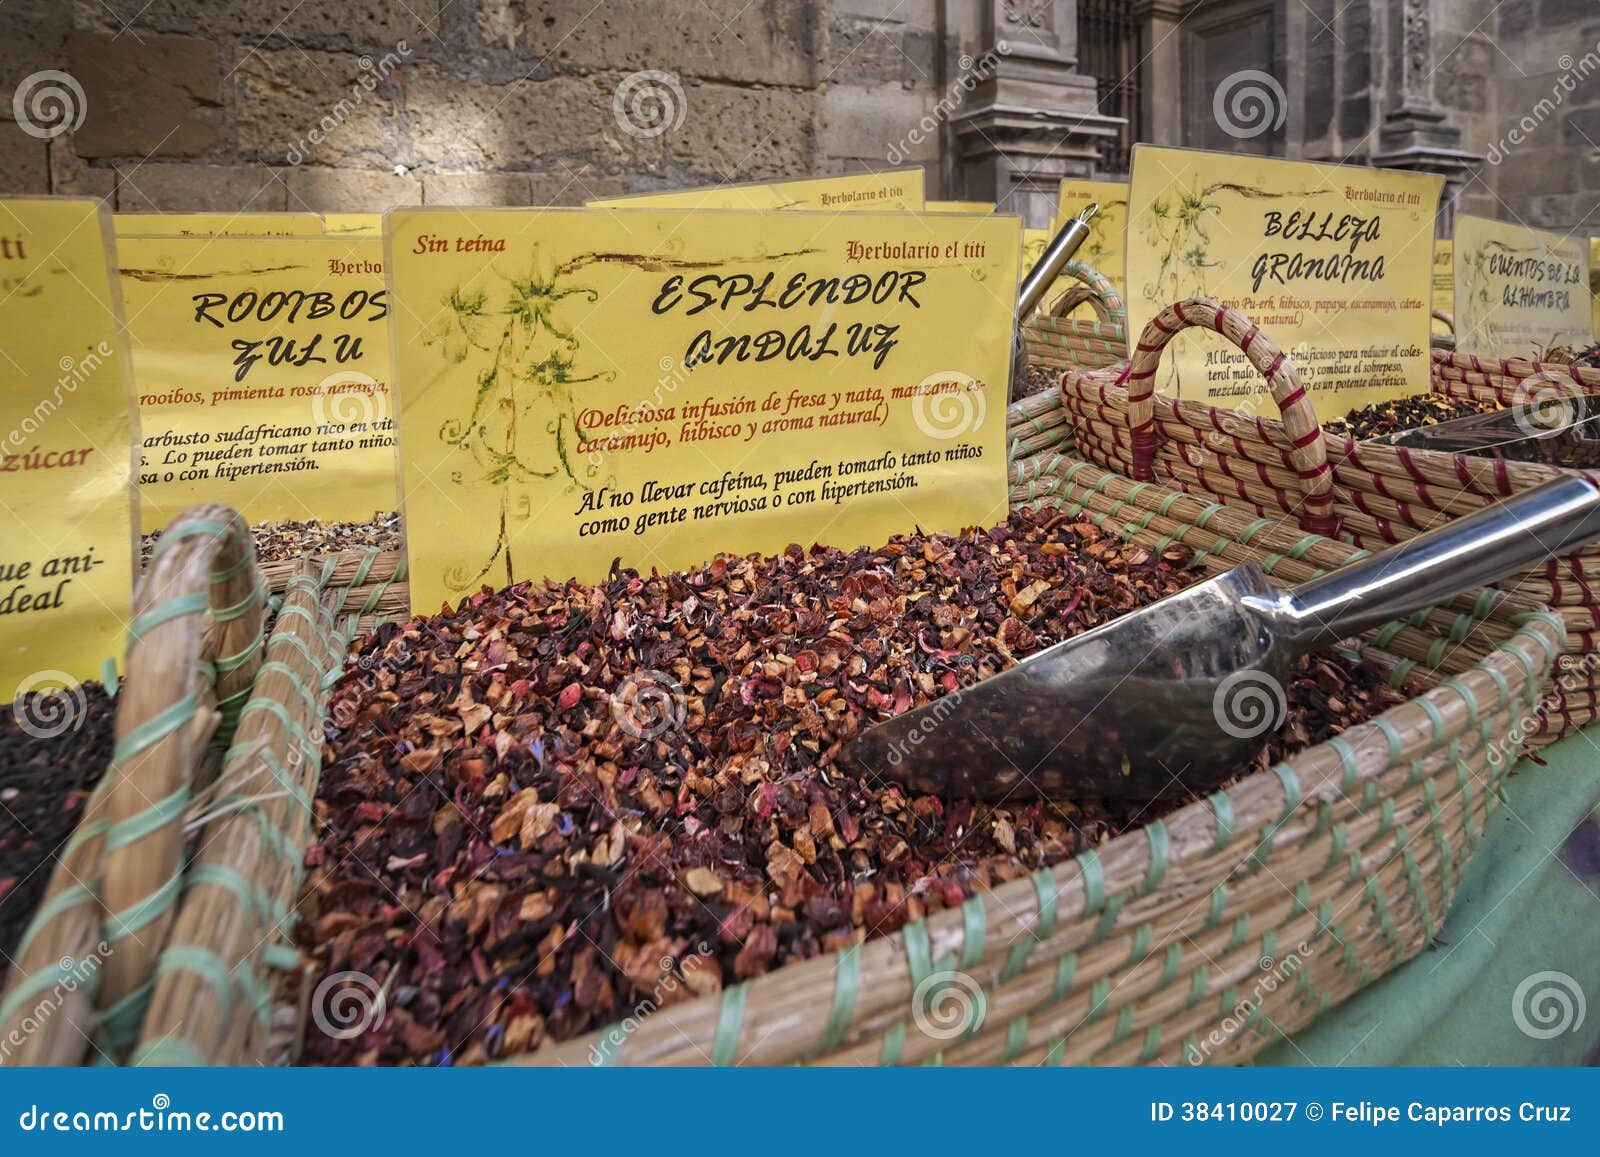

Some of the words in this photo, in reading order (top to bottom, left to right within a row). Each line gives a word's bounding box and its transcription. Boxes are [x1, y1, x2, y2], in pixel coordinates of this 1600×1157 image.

[878, 187, 887, 198] el
[1397, 192, 1405, 204] el
[413, 234, 448, 254] Sin
[455, 234, 505, 252] teína
[1264, 210, 1380, 254] BELLEZA
[846, 241, 939, 262] Herbolario
[945, 241, 958, 258] el
[963, 241, 986, 258] titi
[1489, 253, 1546, 282] CUENTOS
[1548, 263, 1562, 283] DE
[651, 270, 927, 316] ESPLENDOR
[1279, 296, 1312, 311] hibisco,
[1503, 284, 1571, 313] ALHAMBRA
[192, 289, 392, 328] ROOIBOS
[231, 333, 364, 382] ZULU
[684, 322, 900, 370] ANDALUZ
[1204, 350, 1219, 367] Al
[1220, 350, 1246, 365] llevar
[1338, 349, 1358, 363] para
[1391, 345, 1400, 357] el
[1400, 344, 1423, 358] coles-
[1208, 365, 1231, 381] terol
[1232, 364, 1254, 380] malo
[1310, 368, 1316, 379] y
[1317, 361, 1351, 375] combate
[1354, 360, 1362, 373] el
[139, 388, 206, 406] rooibos,
[210, 385, 285, 406] pimienta
[290, 384, 325, 399] rosa,
[327, 379, 389, 398] naranja,
[1208, 381, 1251, 397] mezclado
[1322, 381, 1333, 390] un
[1335, 378, 1367, 393] potente
[575, 405, 676, 432] (Deliciosa
[681, 396, 757, 421] infusión
[761, 392, 781, 412] de
[781, 390, 826, 415] fresa
[828, 392, 841, 411] y
[846, 387, 885, 404] nata,
[892, 380, 961, 399] manzana,
[966, 378, 986, 392] es-
[143, 430, 210, 448] arbusto
[214, 424, 312, 445] sudafricano
[317, 420, 345, 436] rico
[350, 422, 367, 433] en
[576, 426, 672, 454] caramujo,
[679, 420, 741, 443] hibisco
[744, 421, 757, 442] y
[761, 415, 814, 434] aroma
[818, 402, 890, 427] natural.)
[161, 450, 187, 465] Lo
[190, 443, 252, 467] pueden
[259, 442, 308, 457] tomar
[312, 437, 354, 452] tanto
[163, 471, 174, 482] o
[179, 469, 209, 483] con
[215, 457, 319, 481] hipertensión.
[575, 488, 608, 516] Al
[610, 491, 634, 508] no
[640, 480, 696, 504] llevar
[700, 471, 767, 500] cafeína,
[774, 460, 833, 491] pueden
[837, 450, 897, 476] tomarlo
[901, 449, 941, 467] tanto
[945, 443, 984, 461] niños
[579, 516, 630, 537] como
[634, 506, 687, 536] gente
[693, 494, 768, 520] nerviosa
[772, 494, 782, 508] o
[787, 489, 816, 506] con
[821, 472, 919, 505] hipertensión.
[41, 547, 104, 578] ani-
